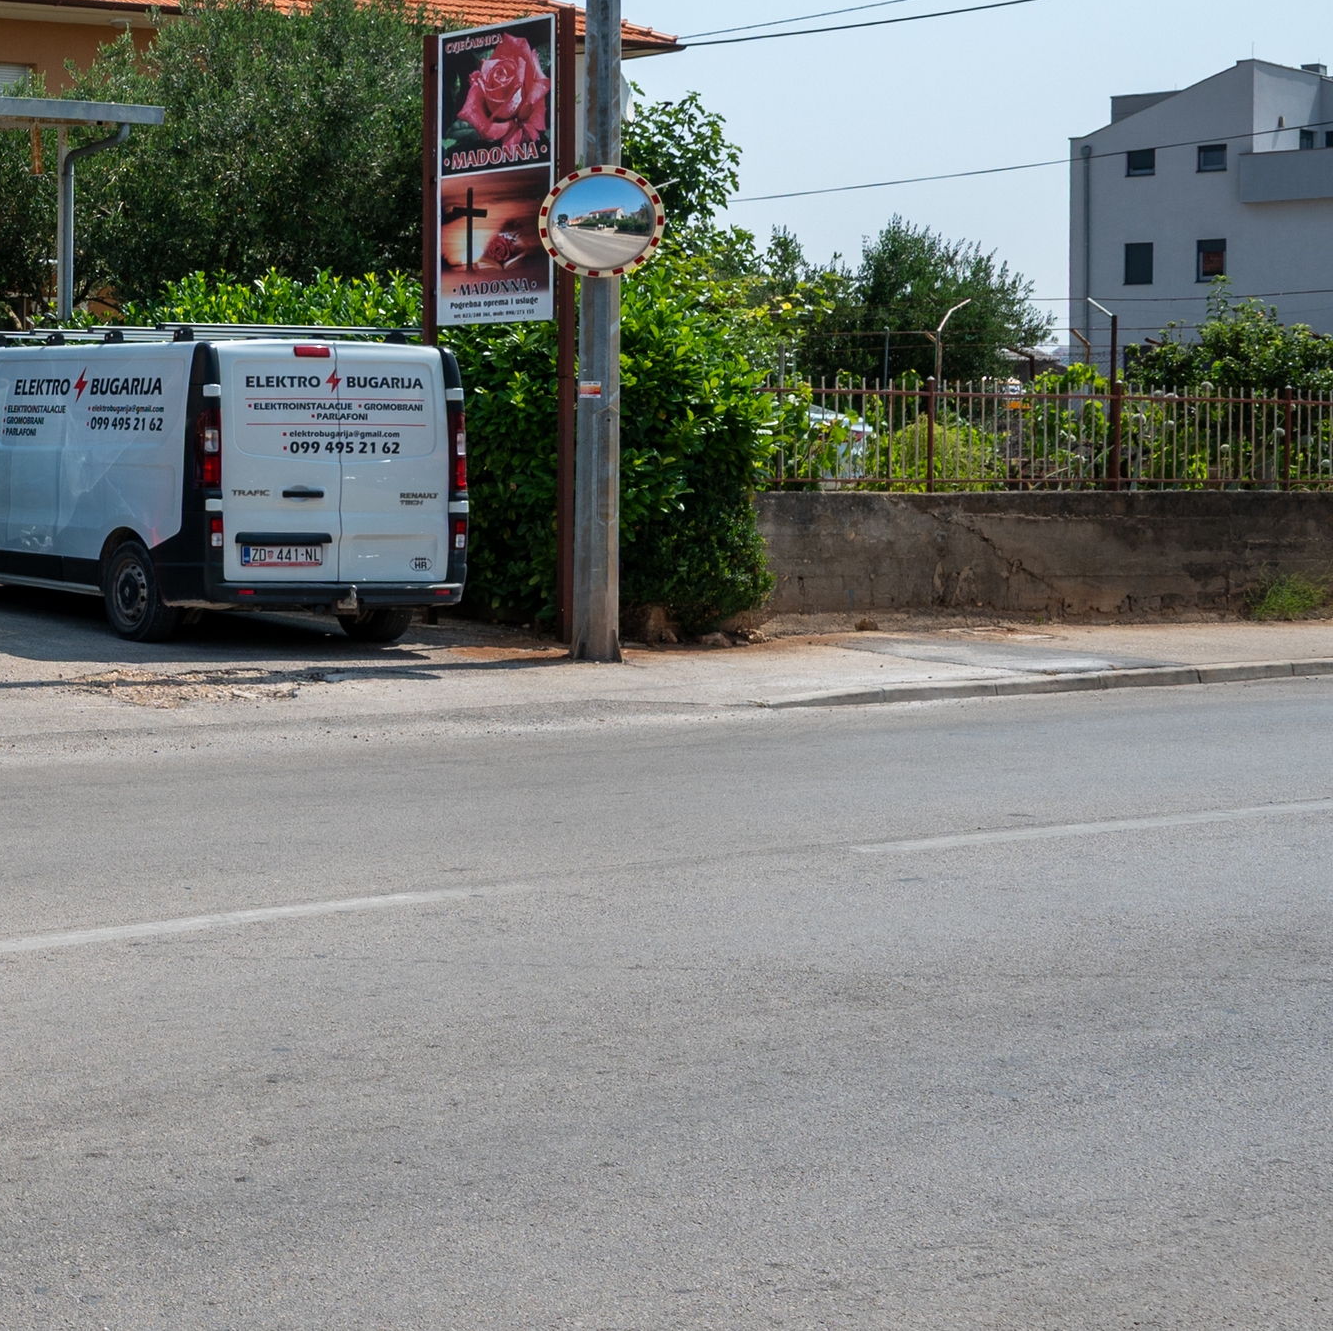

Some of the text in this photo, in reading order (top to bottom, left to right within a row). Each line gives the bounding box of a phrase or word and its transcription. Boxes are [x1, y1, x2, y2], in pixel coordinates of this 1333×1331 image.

[445, 33, 503, 54] CVJEĆARNICA
[451, 142, 539, 170] MADONNA
[459, 278, 530, 296] MADONNA
[450, 300, 481, 310] Pogrebna
[483, 298, 509, 308] oprema
[515, 296, 539, 305] usluge
[14, 377, 163, 396] ELEKTRO BUGARIJA
[245, 376, 424, 389] ELEKTRO BUGARIJA
[7, 405, 67, 414] ELEKTROINSTALACIJE
[253, 402, 423, 412] ELEKTROINSTALACIJE GROMOBRANI
[6, 416, 45, 426] GROMOBRANI
[316, 412, 368, 421] PARLAFONI
[90, 416, 164, 432] 099 495 21 62
[5, 427, 37, 437] PARLAFONI
[289, 430, 400, 440] elektrobugarija@gmail.com
[289, 441, 400, 455] 099 495 21 62
[231, 489, 271, 497] TRAFIC
[251, 547, 267, 562] ZD
[276, 547, 320, 562] 441-NL
[414, 561, 428, 569] HR
